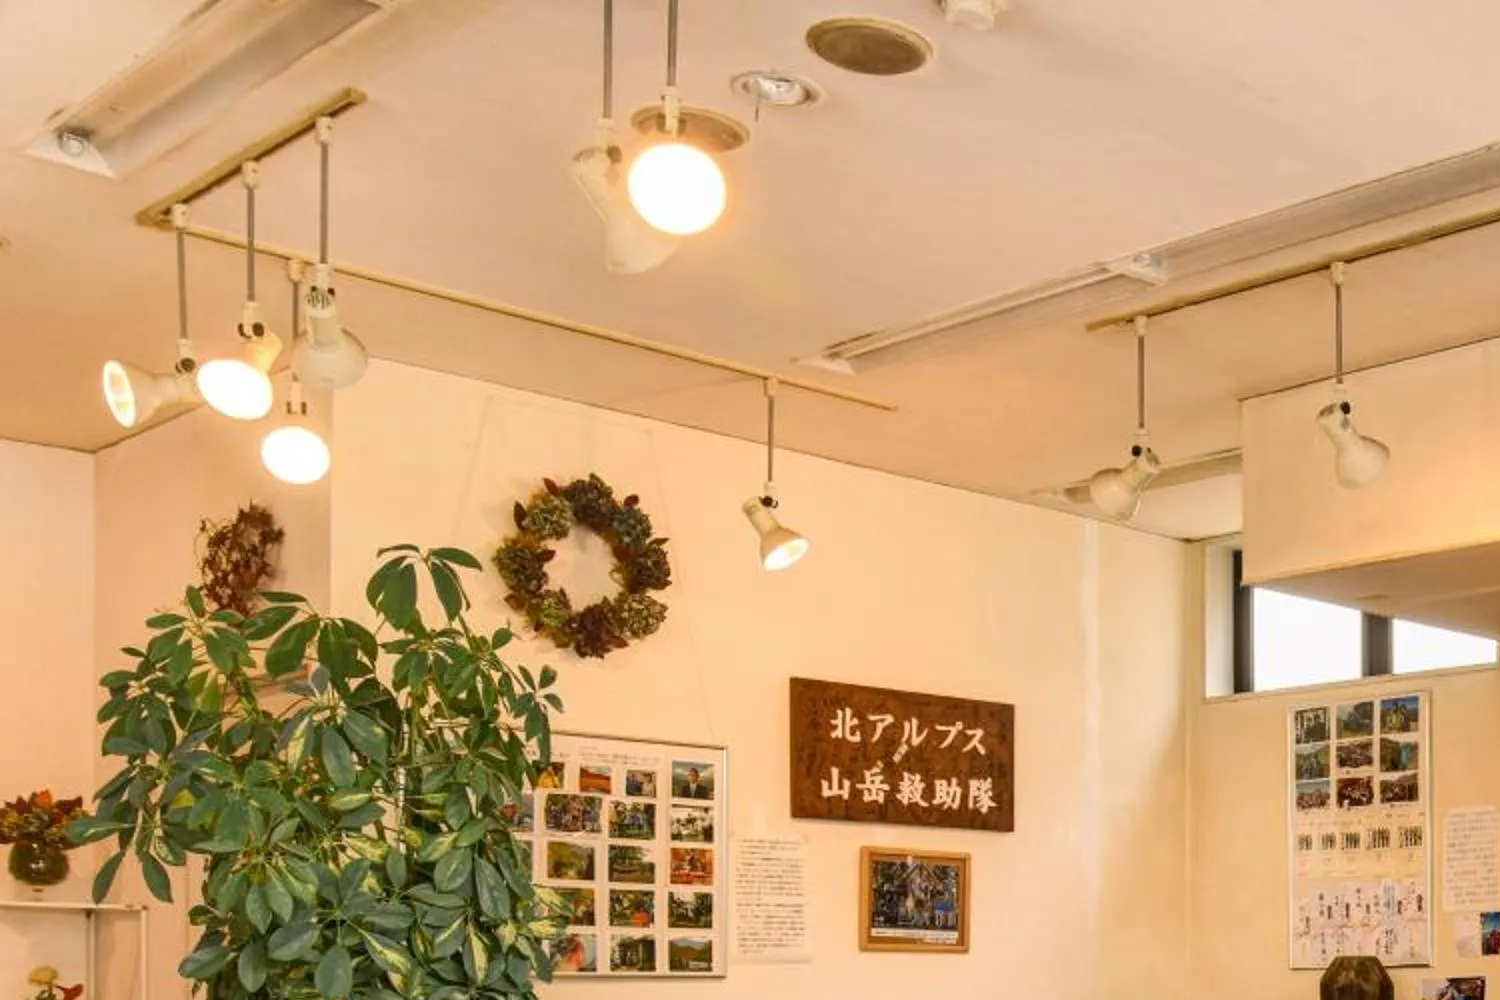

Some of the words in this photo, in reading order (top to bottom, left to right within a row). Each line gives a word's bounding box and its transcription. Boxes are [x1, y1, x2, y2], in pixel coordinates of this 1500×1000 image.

[829, 706, 987, 756] 北アルプス
[820, 760, 998, 815] 山岳救助隊
